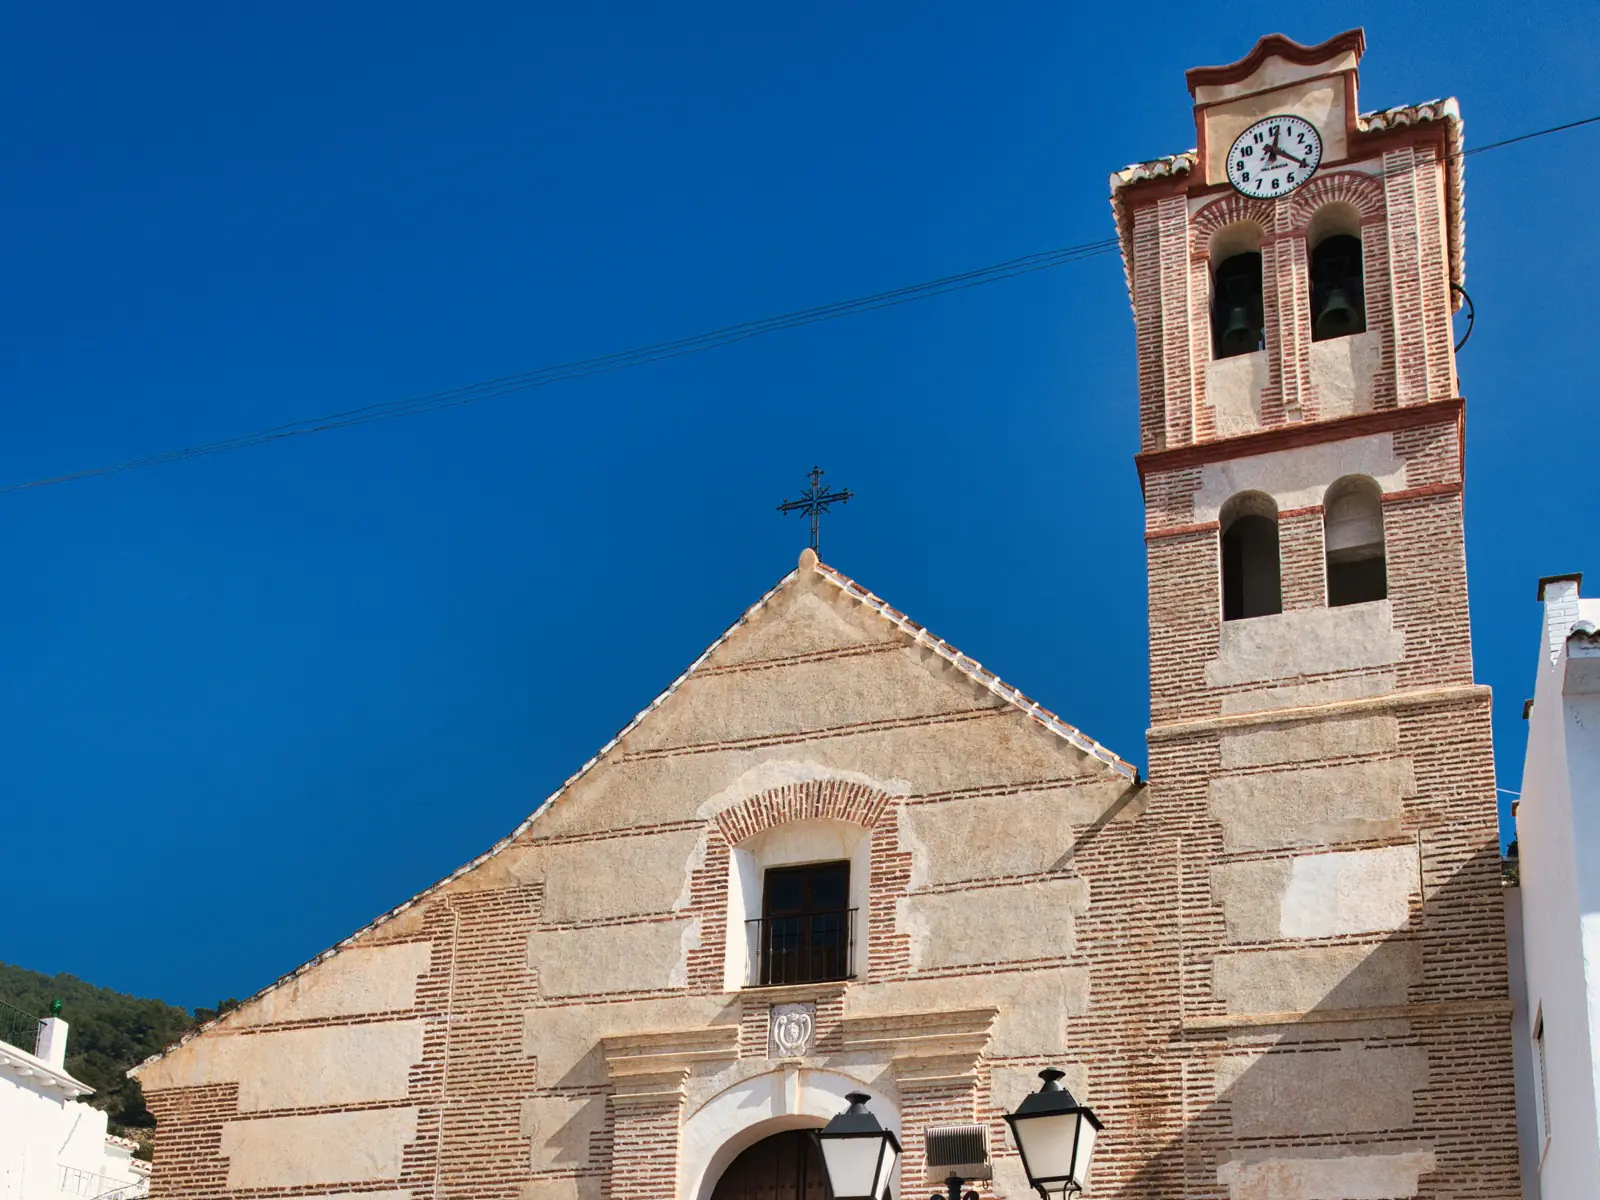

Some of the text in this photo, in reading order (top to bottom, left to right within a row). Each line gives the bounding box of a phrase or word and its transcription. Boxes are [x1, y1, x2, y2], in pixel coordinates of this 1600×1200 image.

[1269, 125, 1280, 137] 12
[1287, 126, 1292, 137] 1
[1253, 132, 1264, 144] 11
[1297, 132, 1306, 144] 2
[1240, 145, 1253, 157] 10
[1304, 144, 1313, 155] 3
[1236, 160, 1244, 171] 9
[1242, 172, 1250, 183] 8
[1286, 172, 1295, 183] 5
[1255, 178, 1263, 190] 7
[1271, 178, 1280, 189] 6
